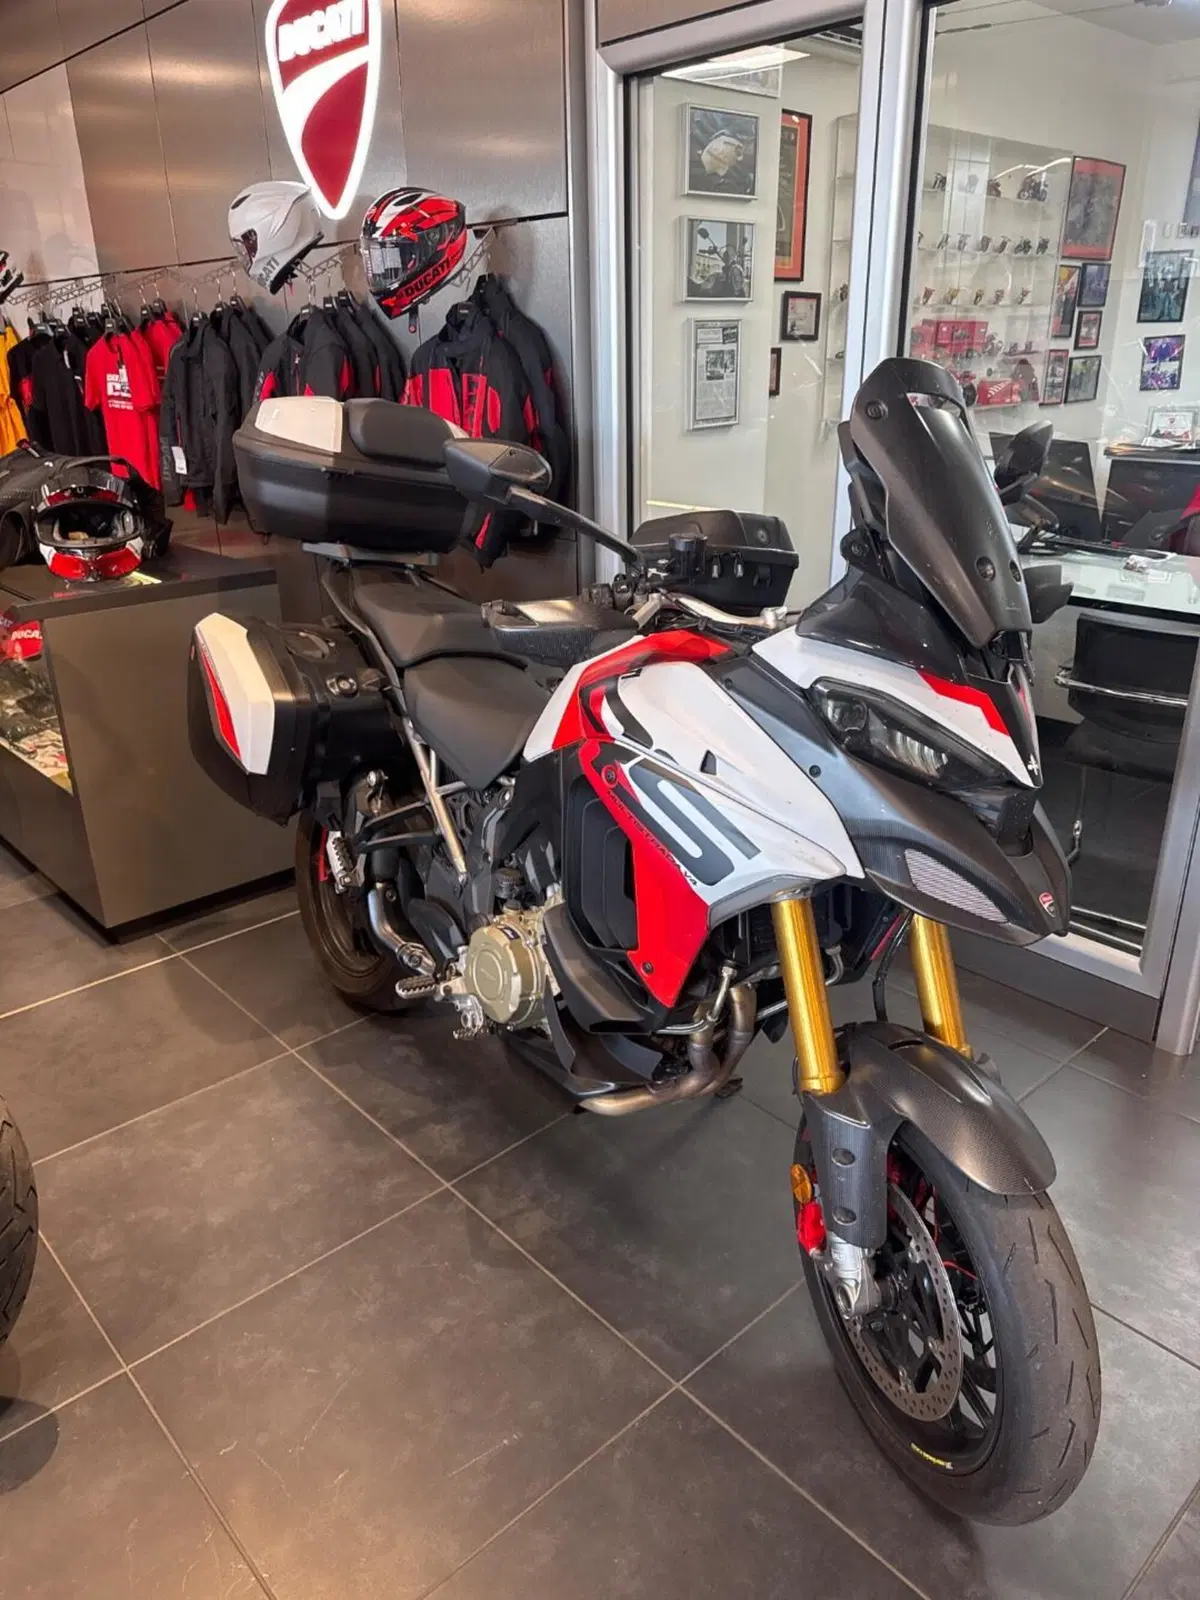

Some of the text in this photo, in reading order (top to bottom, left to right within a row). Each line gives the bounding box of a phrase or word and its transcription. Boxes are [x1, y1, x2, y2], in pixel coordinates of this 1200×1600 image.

[278, 0, 364, 62] DUCATI
[404, 260, 450, 297] DUCATI
[11, 629, 43, 641] DUCA
[608, 788, 699, 887] MULTISTRADA V4
